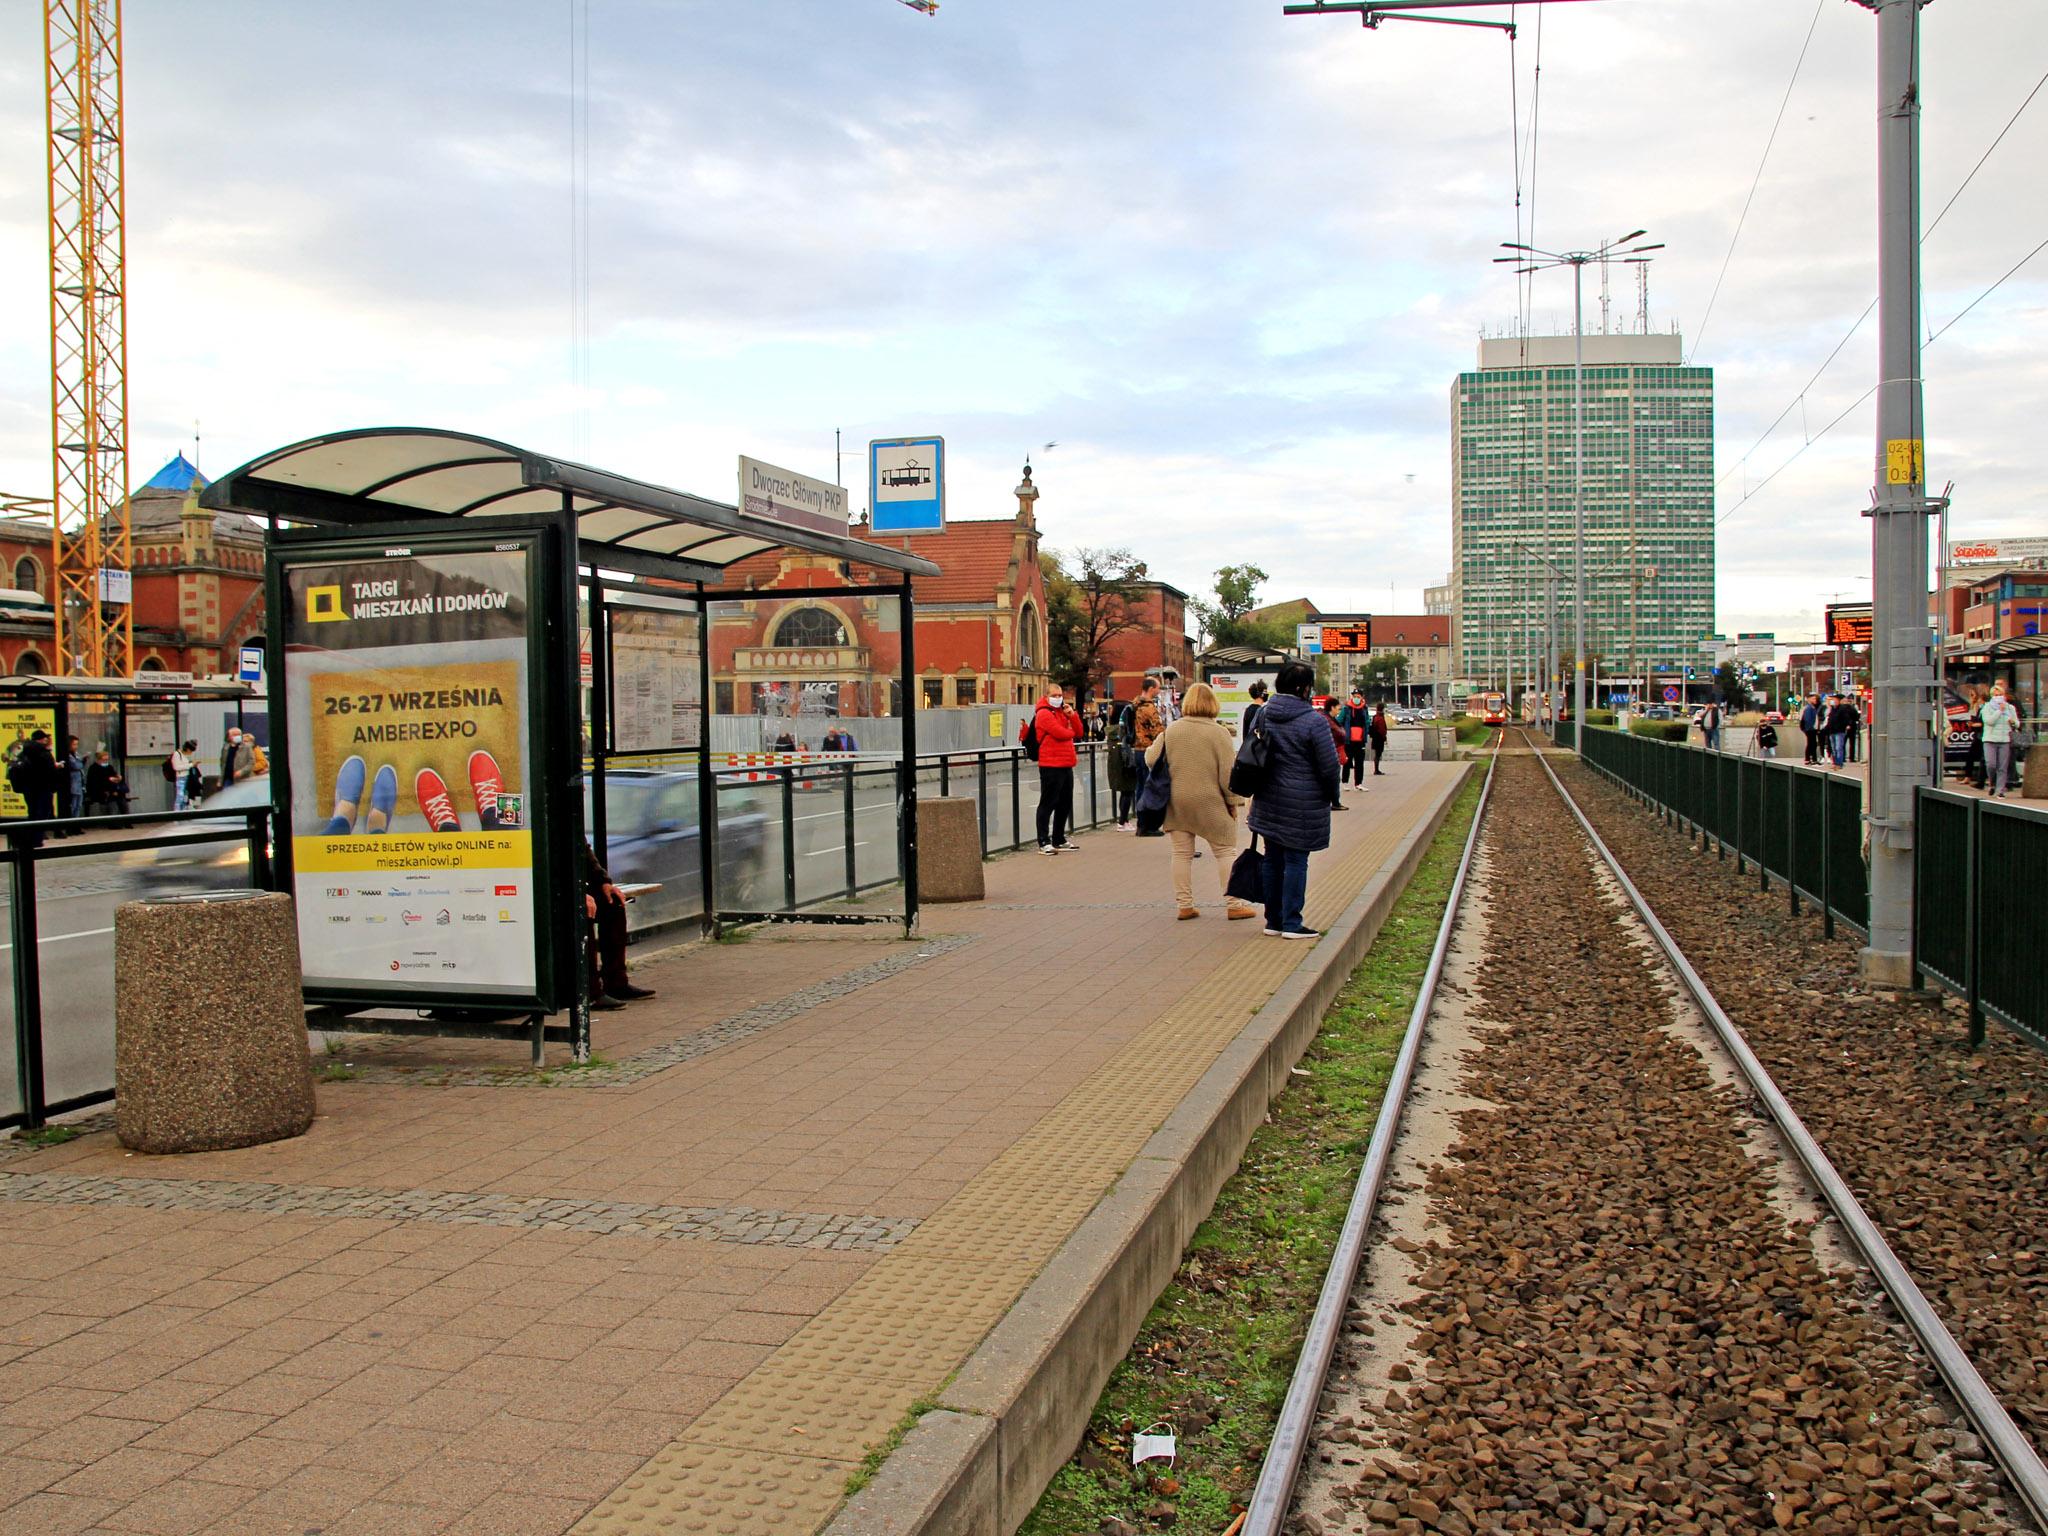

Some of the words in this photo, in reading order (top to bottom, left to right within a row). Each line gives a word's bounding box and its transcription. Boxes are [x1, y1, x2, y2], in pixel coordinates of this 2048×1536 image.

[1901, 470, 1921, 481] 36
[752, 466, 790, 498] Dworzec
[792, 479, 823, 513] Główny
[824, 489, 841, 513] PKP
[352, 580, 399, 599] TARGI
[353, 593, 434, 620] MIESZKAŃ
[436, 596, 442, 613] I
[445, 588, 509, 613] DOMÓW
[804, 682, 838, 695] KFC
[324, 694, 384, 716] 26-27
[388, 685, 503, 712] WRZEŚNIA
[352, 720, 478, 744] AMBEREXPO
[326, 840, 380, 854] SPRZEDAŻ
[382, 839, 425, 853] BILETÓW
[428, 841, 453, 854] tylko
[456, 840, 495, 850] ONLINE
[498, 840, 512, 850] na:
[376, 855, 463, 869] mieszkaniowi.pl
